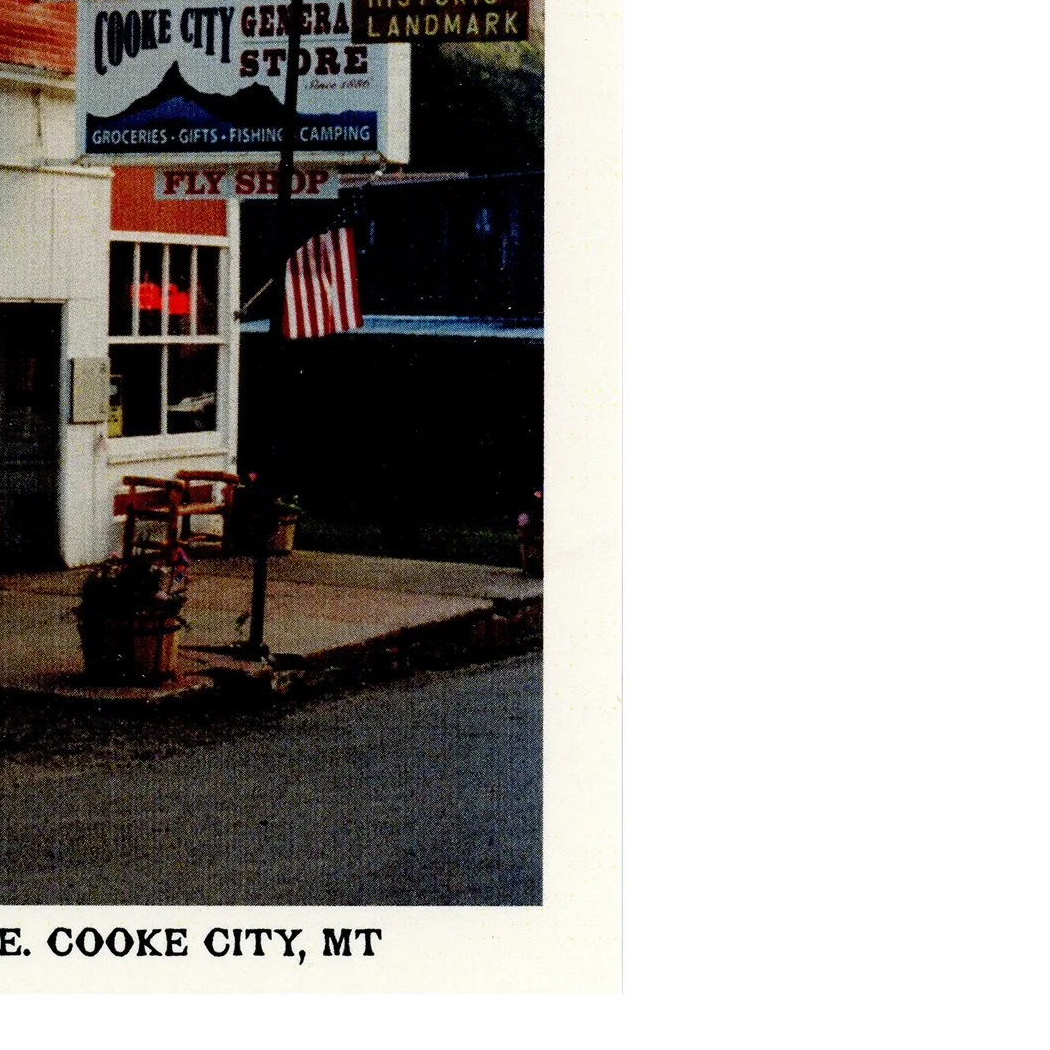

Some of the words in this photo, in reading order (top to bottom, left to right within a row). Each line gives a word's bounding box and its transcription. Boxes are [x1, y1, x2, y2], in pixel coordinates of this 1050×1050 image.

[240, 3, 350, 38] GENERA
[367, 10, 518, 38] LANDMARK
[94, 9, 172, 76] COOKE
[180, 6, 235, 64] CITY
[92, 129, 168, 145] GROCERIES
[179, 128, 218, 144] GIFTS
[300, 125, 371, 142] CAMPING
[163, 170, 226, 195] FLY
